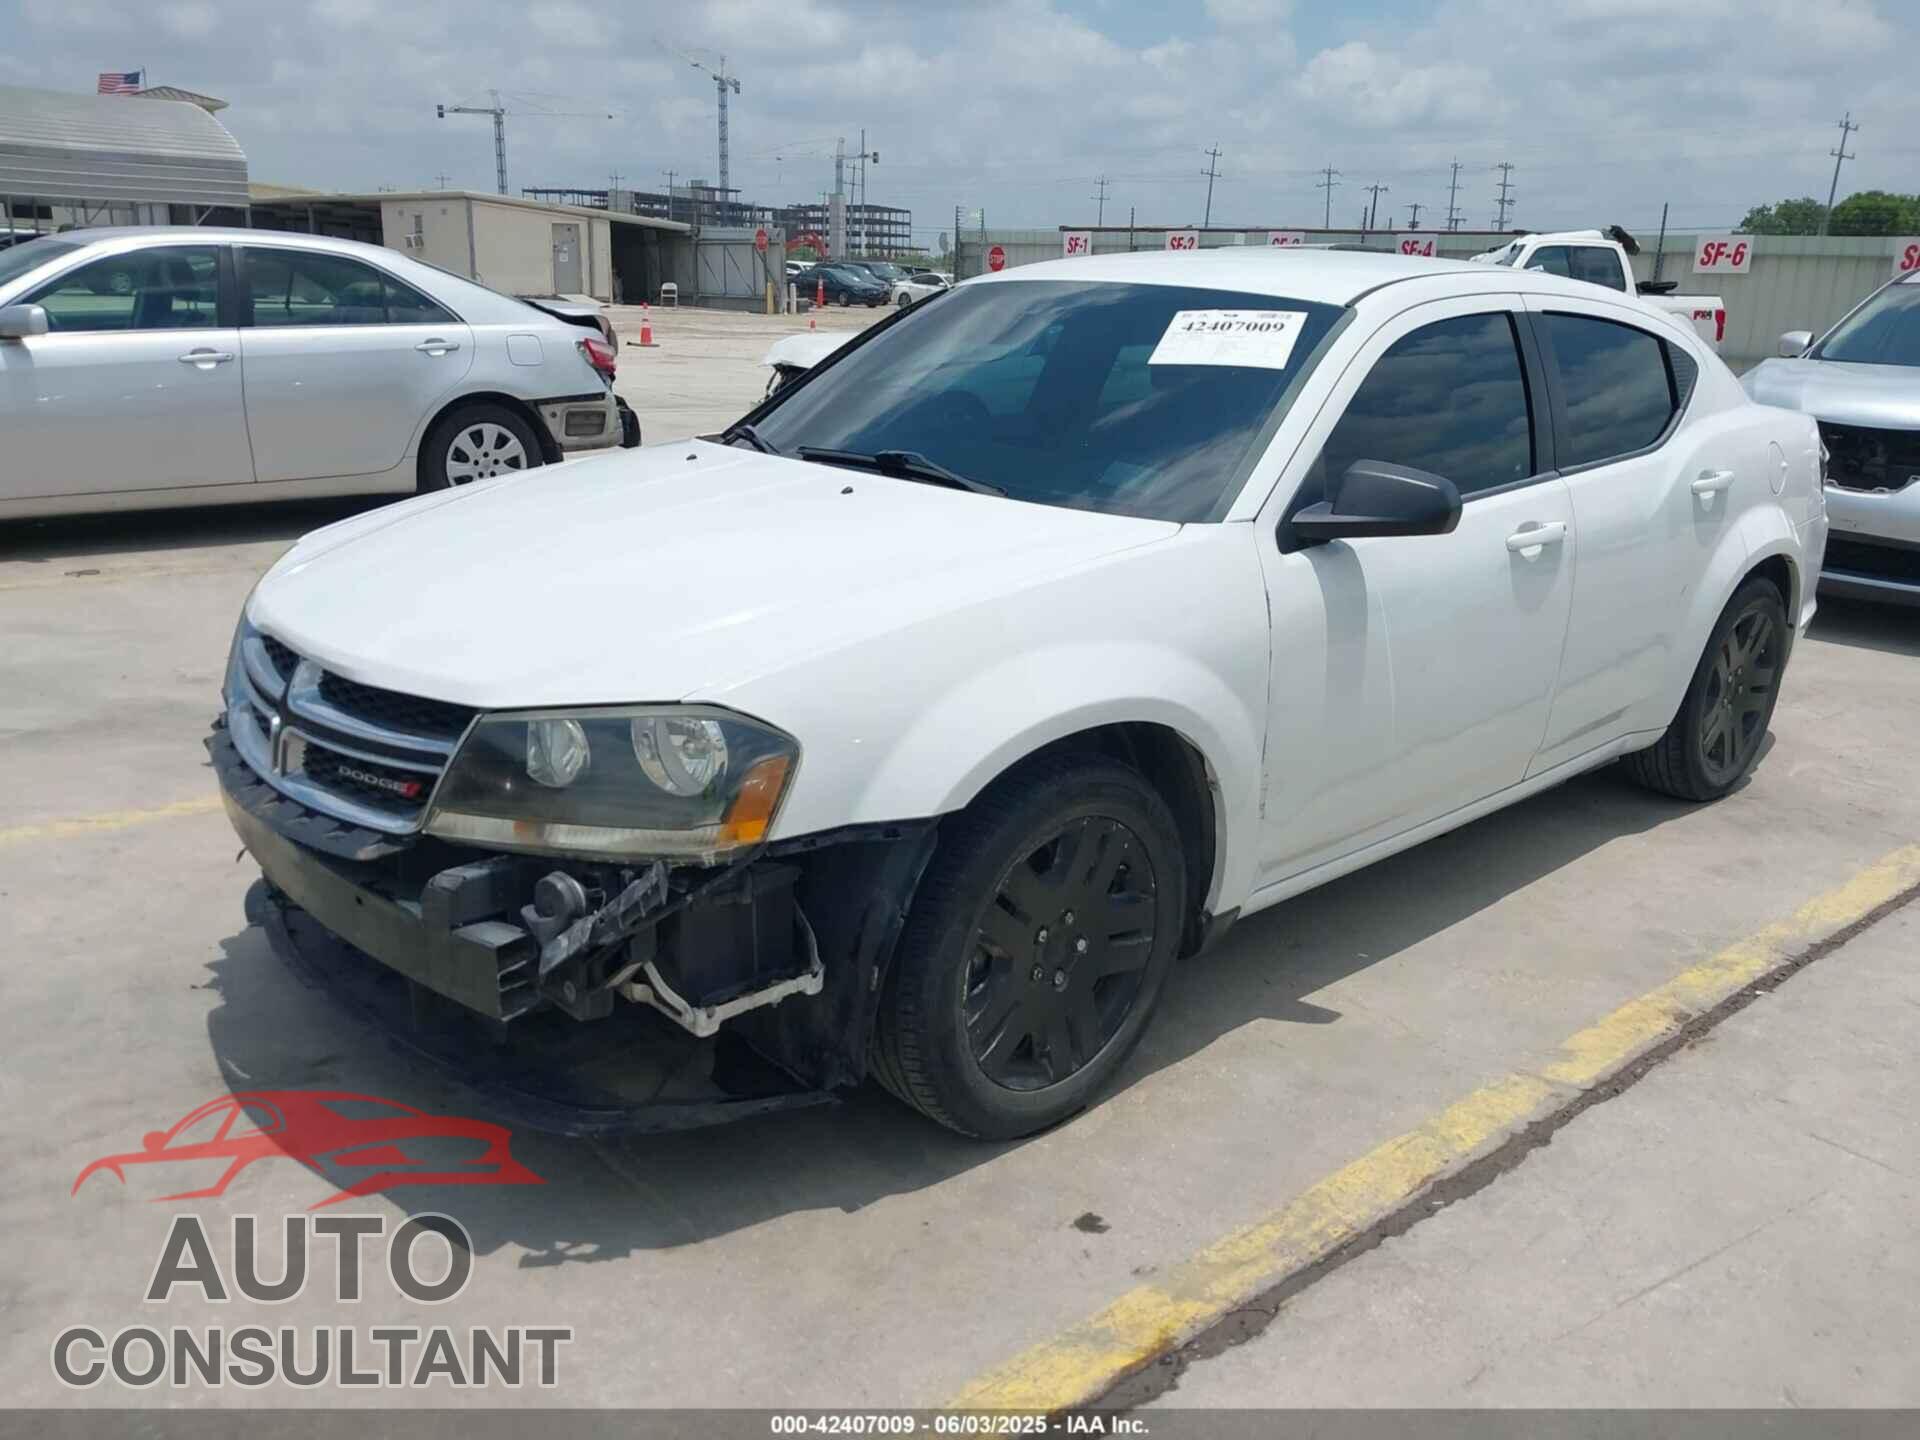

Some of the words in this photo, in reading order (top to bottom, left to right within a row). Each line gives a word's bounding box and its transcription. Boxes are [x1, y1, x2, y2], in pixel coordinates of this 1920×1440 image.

[1067, 237, 1088, 254] SF-1
[1402, 240, 1433, 256] SF-4
[1700, 242, 1747, 266] SF-6
[1181, 320, 1285, 332] 42407009
[338, 765, 408, 793] DODGE
